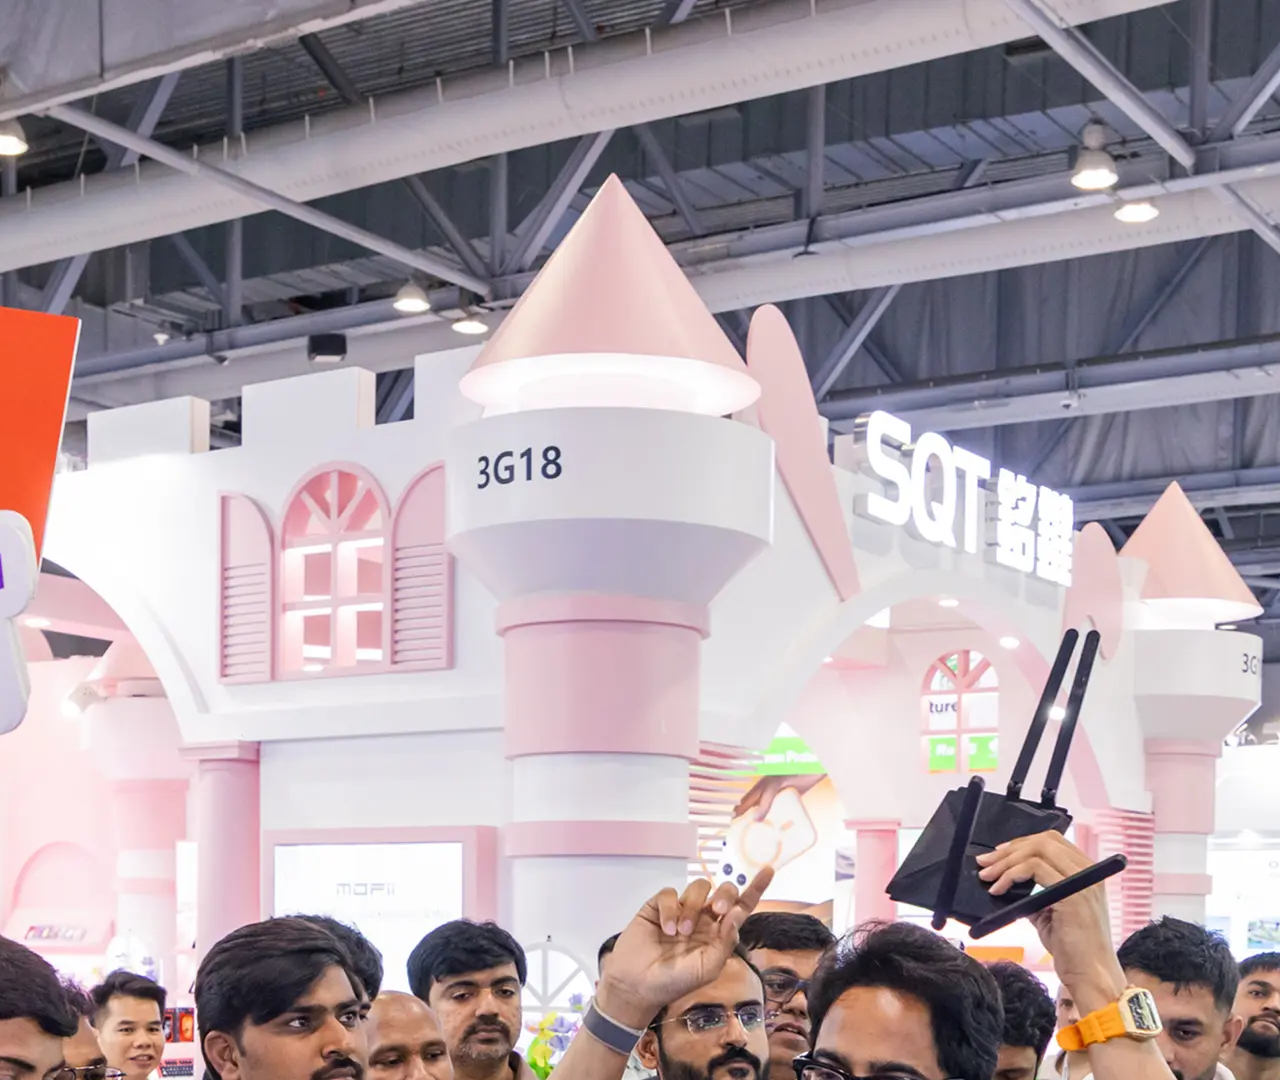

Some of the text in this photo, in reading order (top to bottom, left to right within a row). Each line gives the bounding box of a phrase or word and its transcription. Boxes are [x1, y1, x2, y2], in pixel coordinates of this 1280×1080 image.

[477, 445, 562, 489] 3G18
[867, 410, 991, 553] SQT
[1242, 653, 1261, 674] 3G
